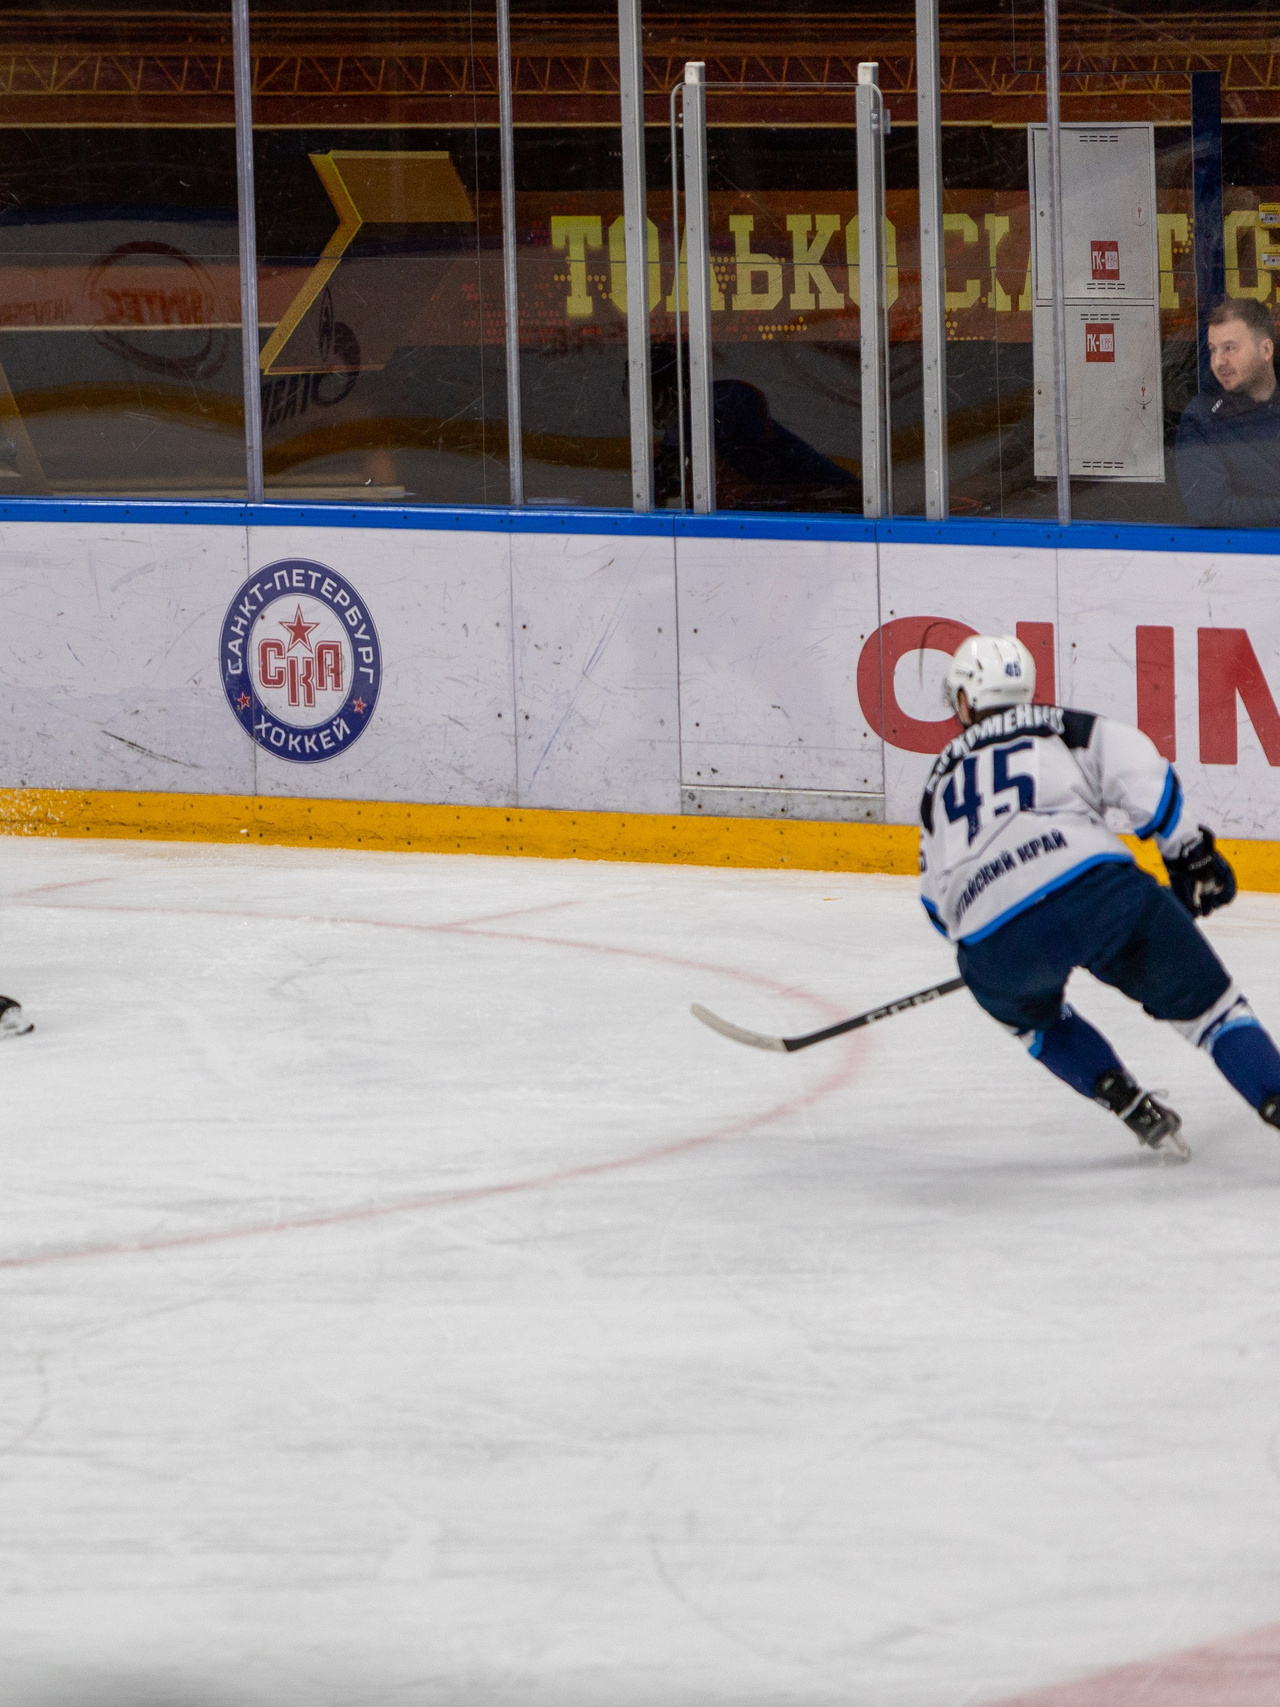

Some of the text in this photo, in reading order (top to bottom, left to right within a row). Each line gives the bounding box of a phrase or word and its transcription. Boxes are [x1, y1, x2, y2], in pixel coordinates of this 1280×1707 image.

[227, 568, 374, 684] САНКТ-ПЕТЕРБУРГ
[258, 637, 344, 708] СКА
[255, 714, 351, 754] ХОККЕЙ
[943, 738, 1036, 848] 45
